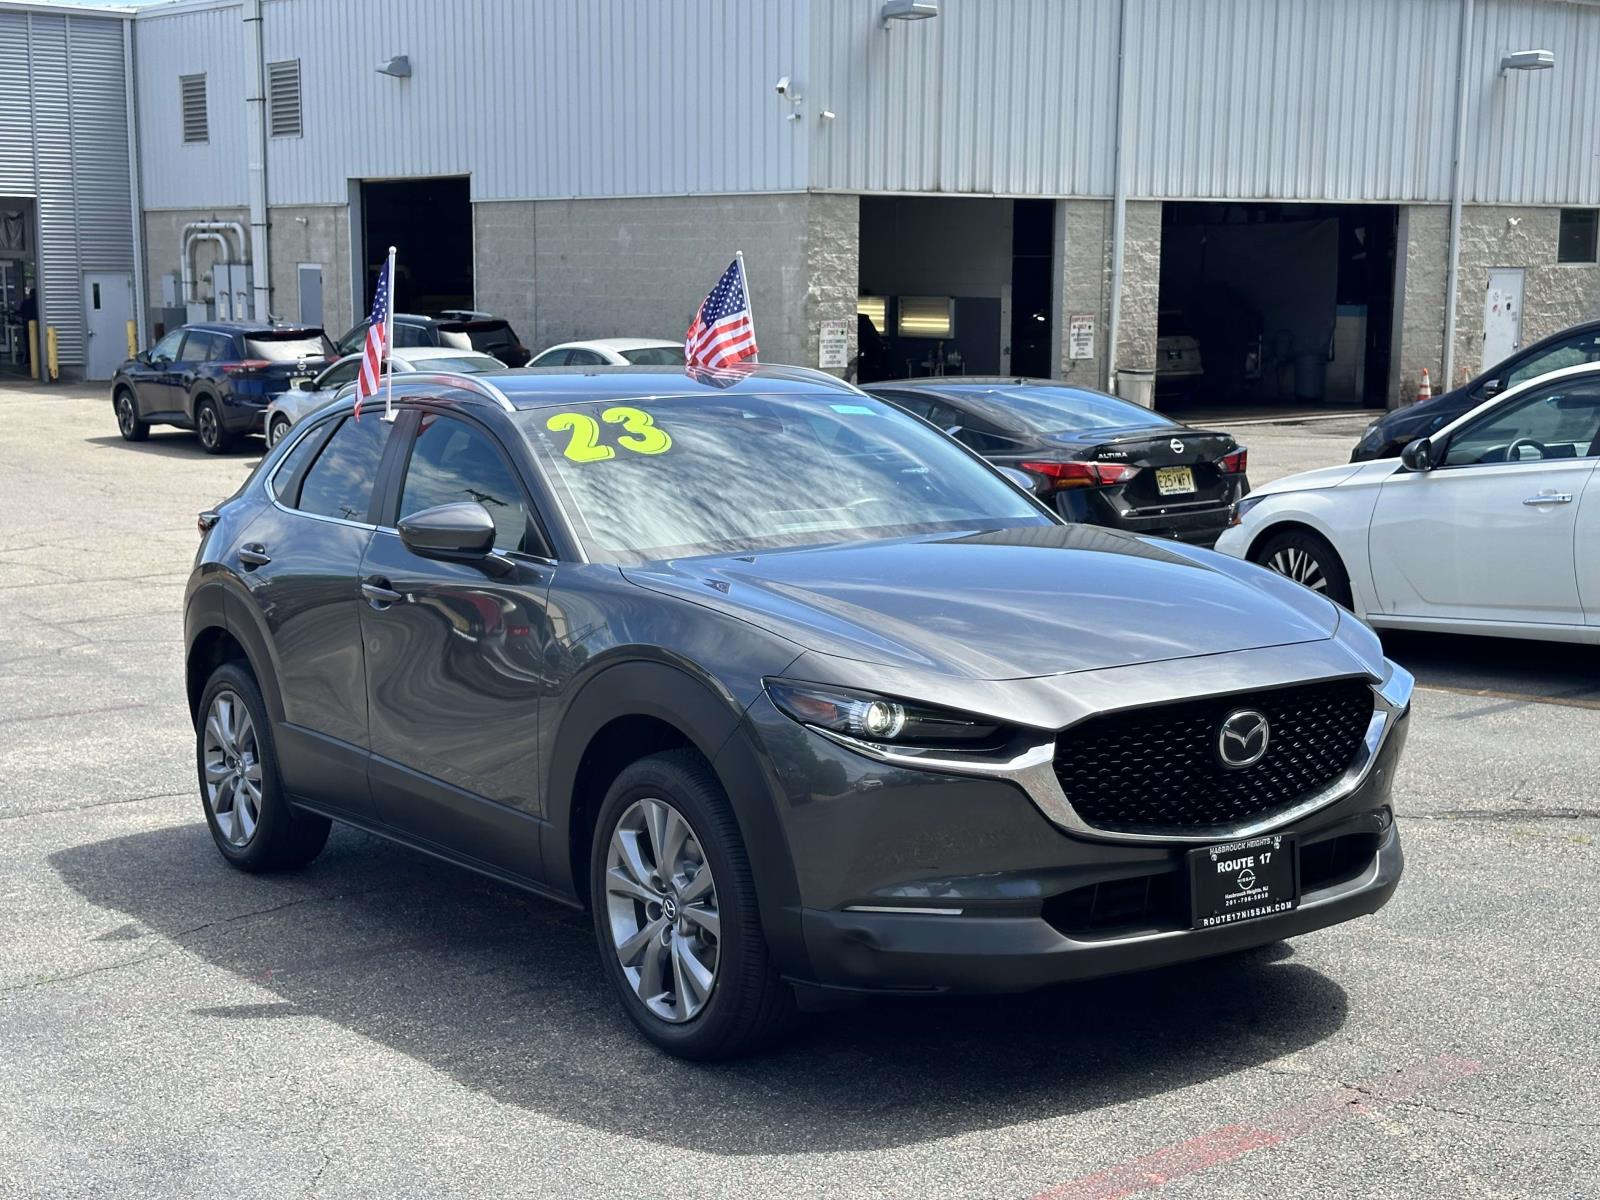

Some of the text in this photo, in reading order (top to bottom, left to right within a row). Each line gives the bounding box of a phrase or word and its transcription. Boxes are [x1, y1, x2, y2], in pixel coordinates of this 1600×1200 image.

[546, 406, 673, 463] 23
[1209, 842, 1246, 855] HASBROUCK
[1217, 852, 1271, 873] ROUTE 17
[1203, 901, 1292, 926] ROUTE17NISSAN.COM
